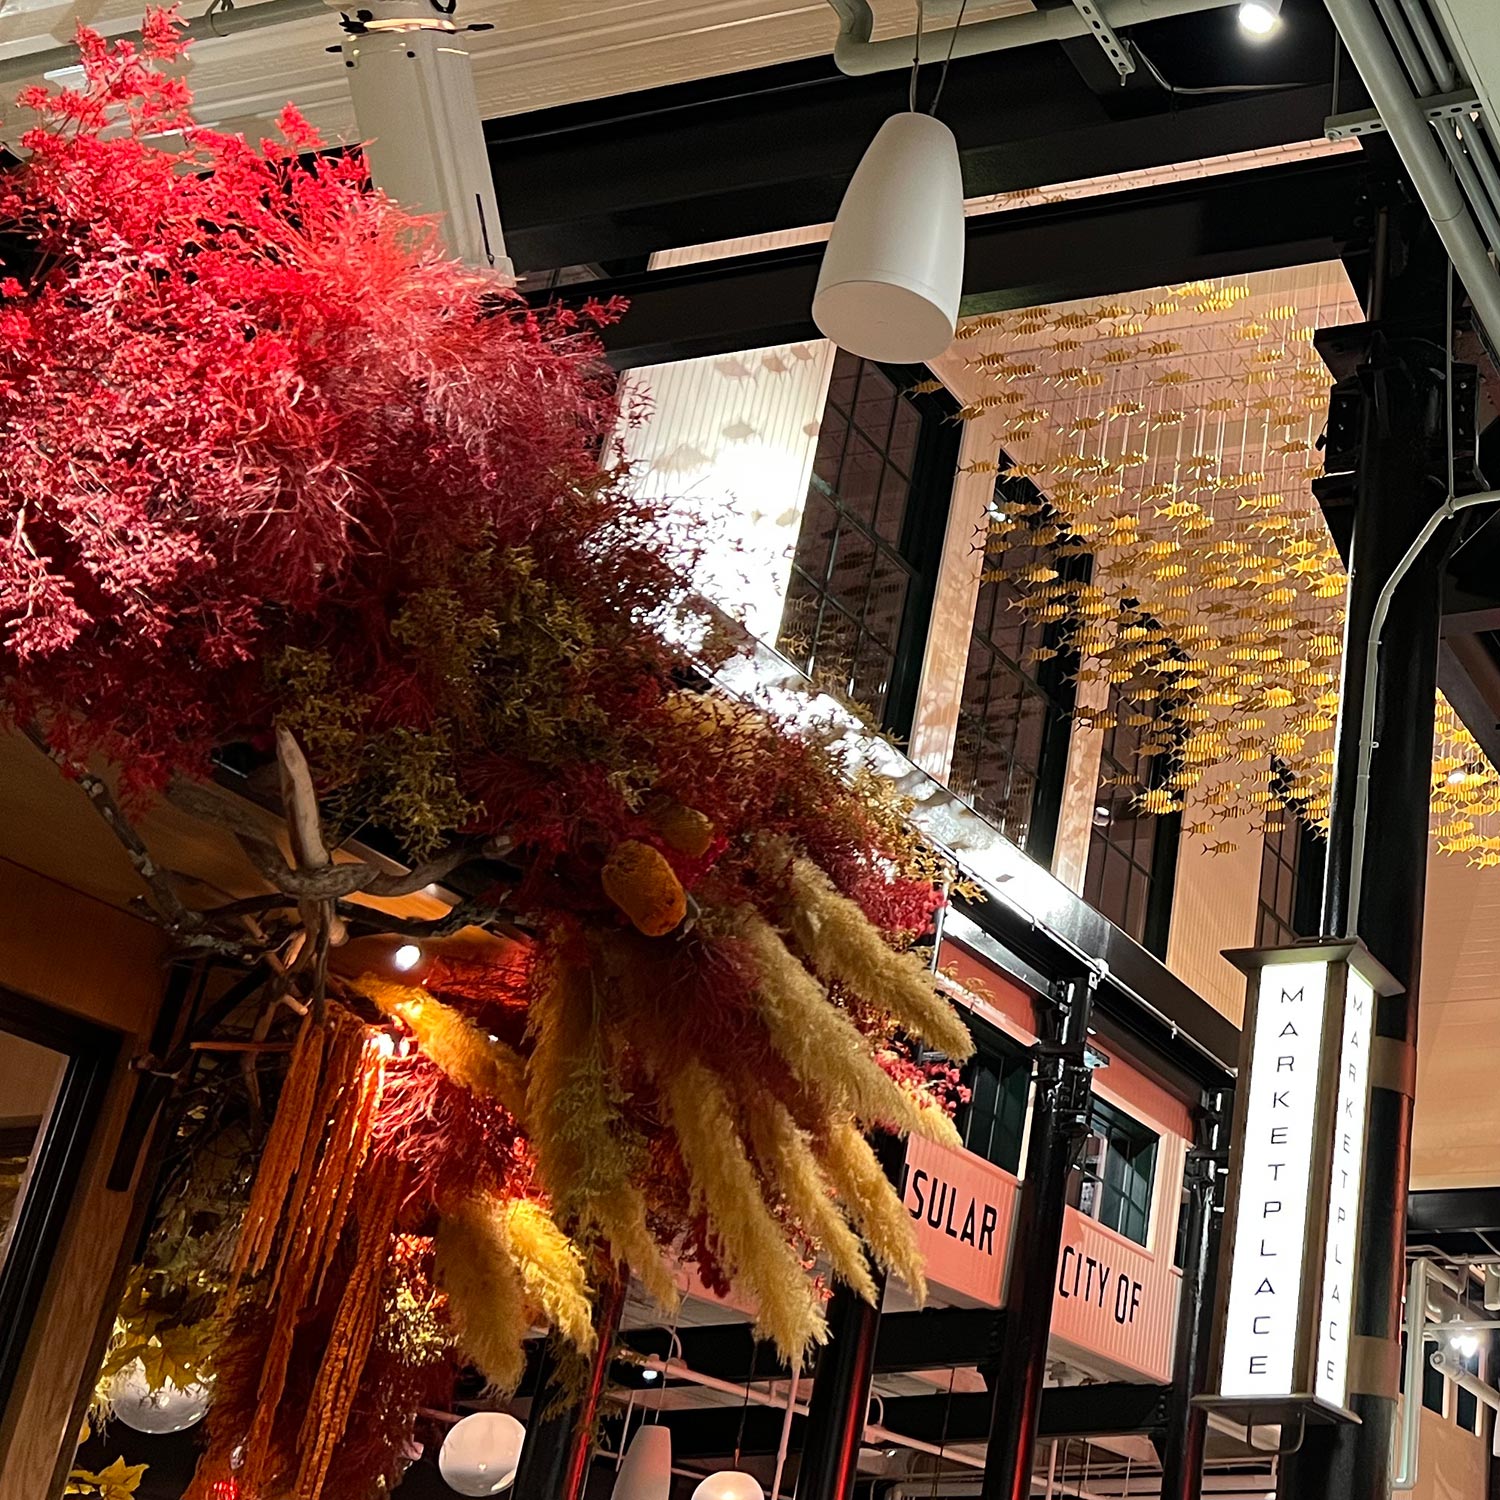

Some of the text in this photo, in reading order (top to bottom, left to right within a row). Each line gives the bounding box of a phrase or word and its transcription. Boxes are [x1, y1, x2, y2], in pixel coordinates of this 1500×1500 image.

[1058, 1245, 1142, 1325] CITY OF
[1249, 987, 1304, 1374] MARKETPLACE
[1326, 994, 1363, 1381] MARKETPLACE
